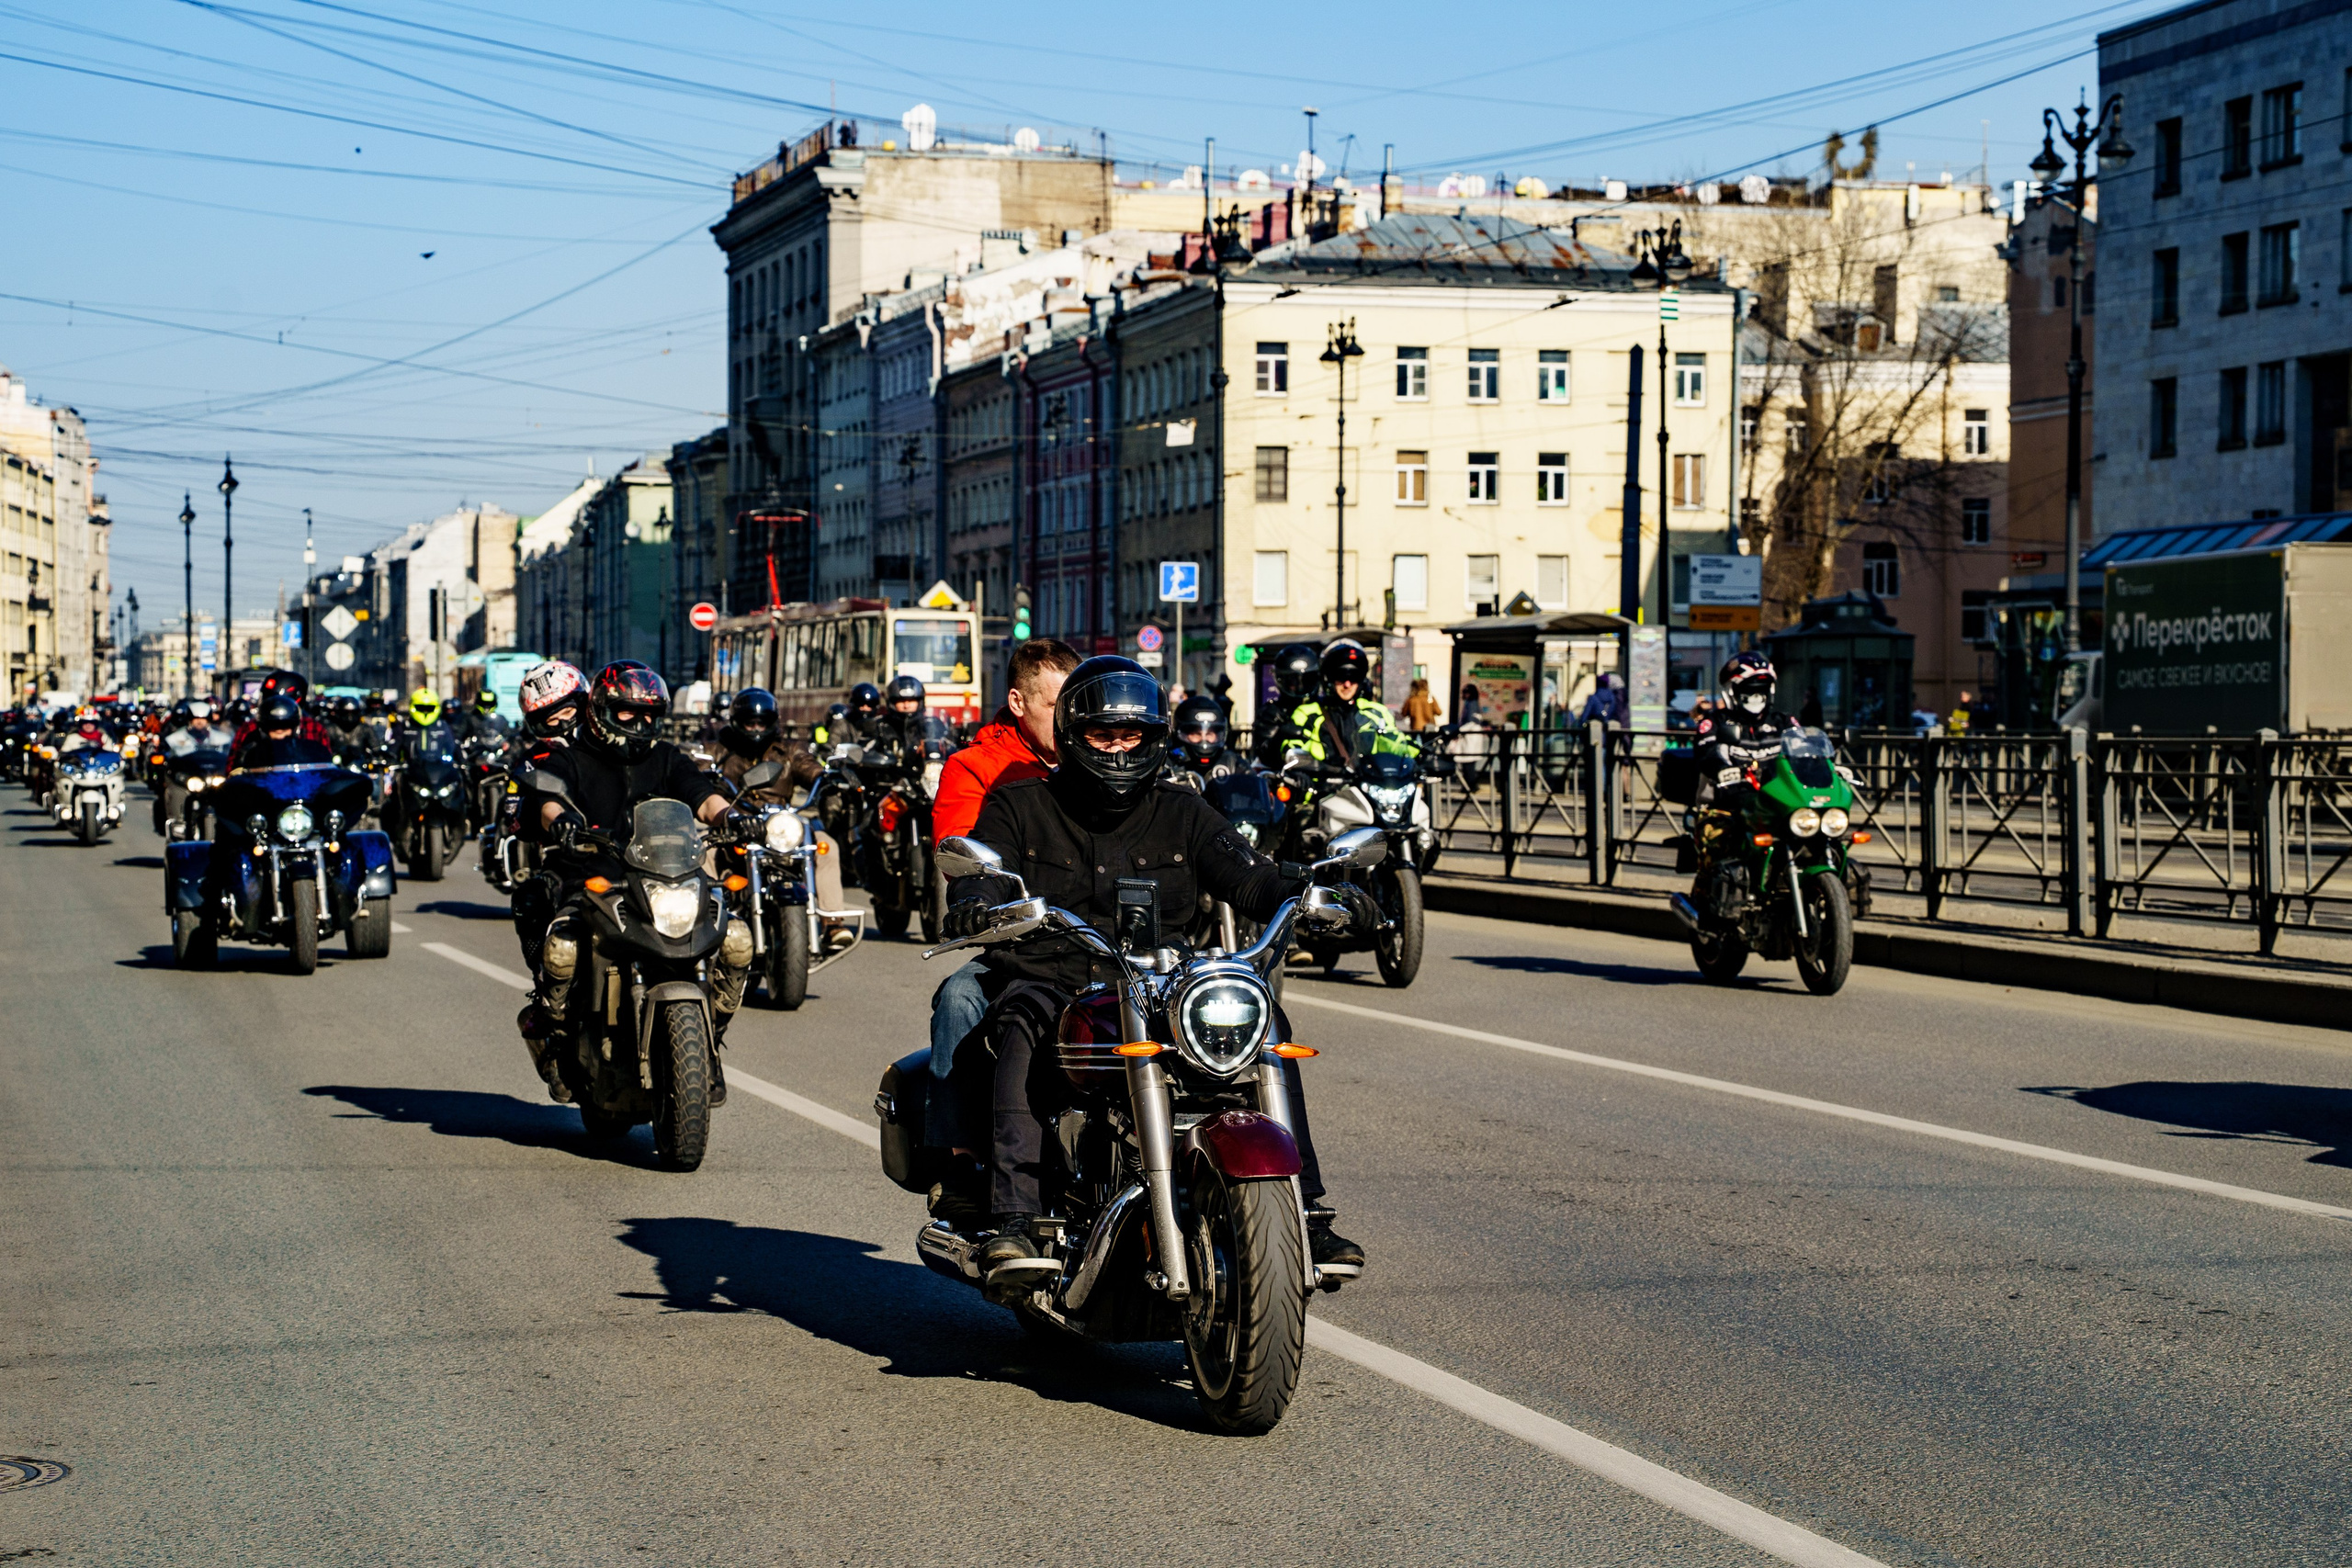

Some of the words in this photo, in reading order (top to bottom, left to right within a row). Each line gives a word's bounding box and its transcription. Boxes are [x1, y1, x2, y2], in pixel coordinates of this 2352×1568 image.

[2132, 606, 2273, 657] Перекрёсток
[2116, 667, 2156, 690] САМОЕ
[2157, 664, 2201, 687] СВЕЖЕЕ
[2203, 663, 2212, 685] И
[2214, 661, 2272, 684] ВКУСНОЕ!
[1102, 704, 1148, 713] LS2
